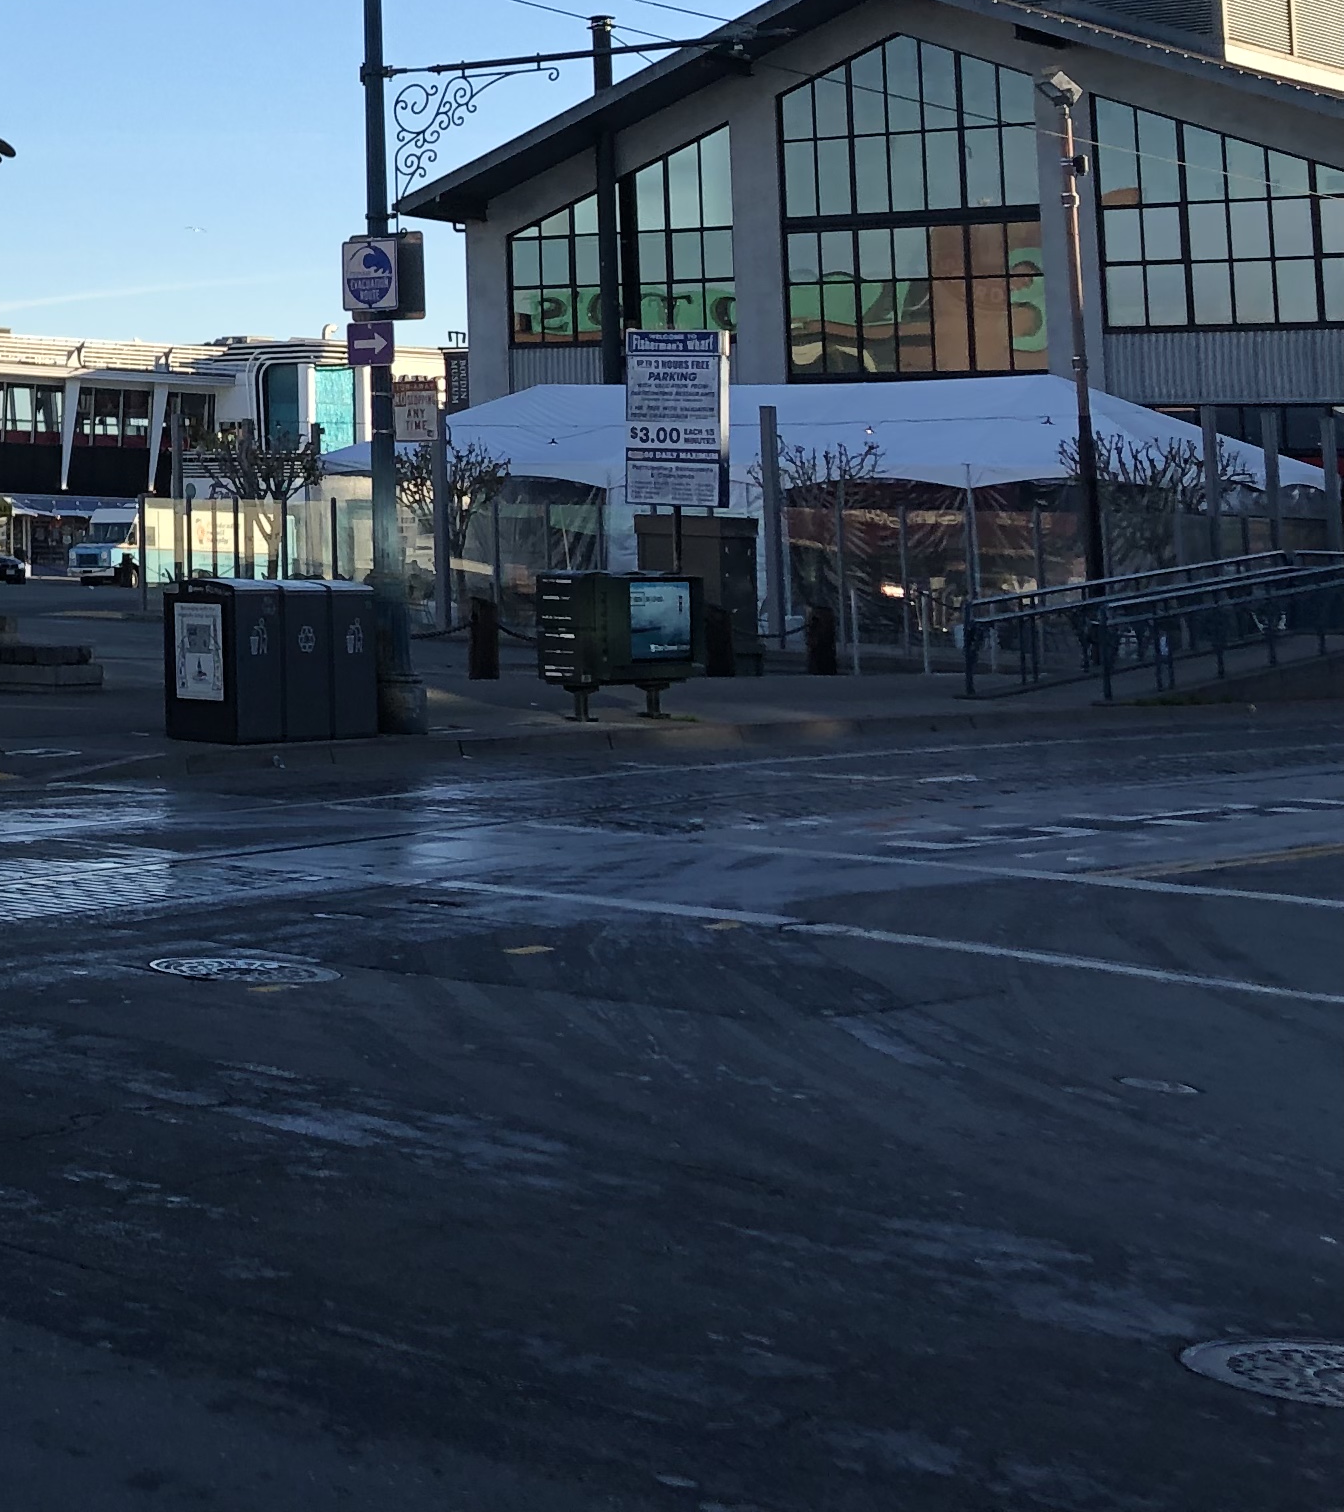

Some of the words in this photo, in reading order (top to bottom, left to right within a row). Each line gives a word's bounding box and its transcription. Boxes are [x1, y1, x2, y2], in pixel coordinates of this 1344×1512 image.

[632, 334, 684, 351] Fisherman's
[686, 334, 714, 351] Wharf
[653, 359, 660, 370] 3
[661, 360, 690, 370] HOURS
[691, 360, 710, 370] FREE
[450, 359, 460, 405] MUSEUM
[459, 359, 467, 401] BOUDIN
[647, 371, 698, 382] PARKING
[406, 408, 426, 419] ANY
[405, 420, 428, 431] TIME
[630, 425, 681, 444] $3.00
